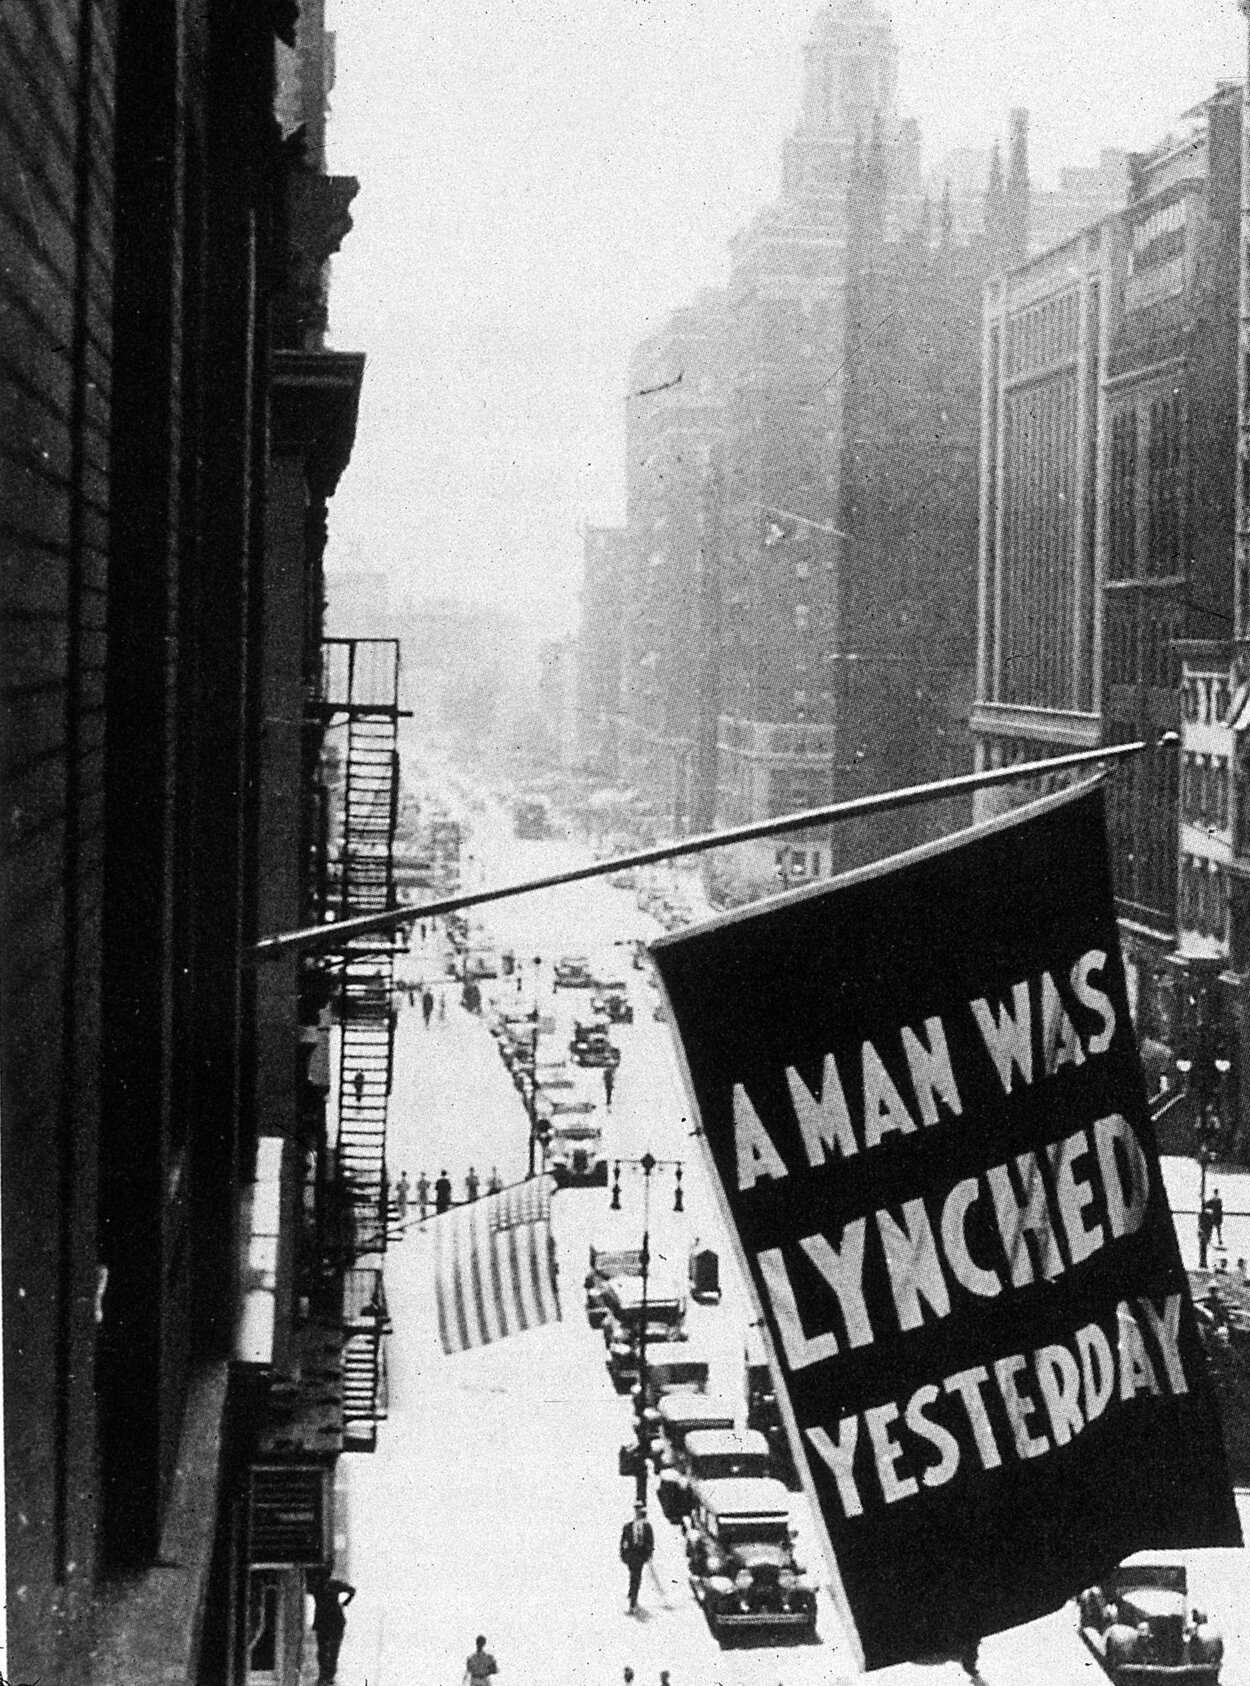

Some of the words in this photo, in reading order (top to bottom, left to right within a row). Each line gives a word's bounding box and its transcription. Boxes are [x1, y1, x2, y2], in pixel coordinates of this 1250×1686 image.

[732, 1082, 789, 1192] A
[785, 1015, 963, 1168] MAN
[969, 948, 1117, 1095] WAS
[756, 1113, 1151, 1372] LYNCHED
[804, 1293, 1189, 1519] YESTERDAY
